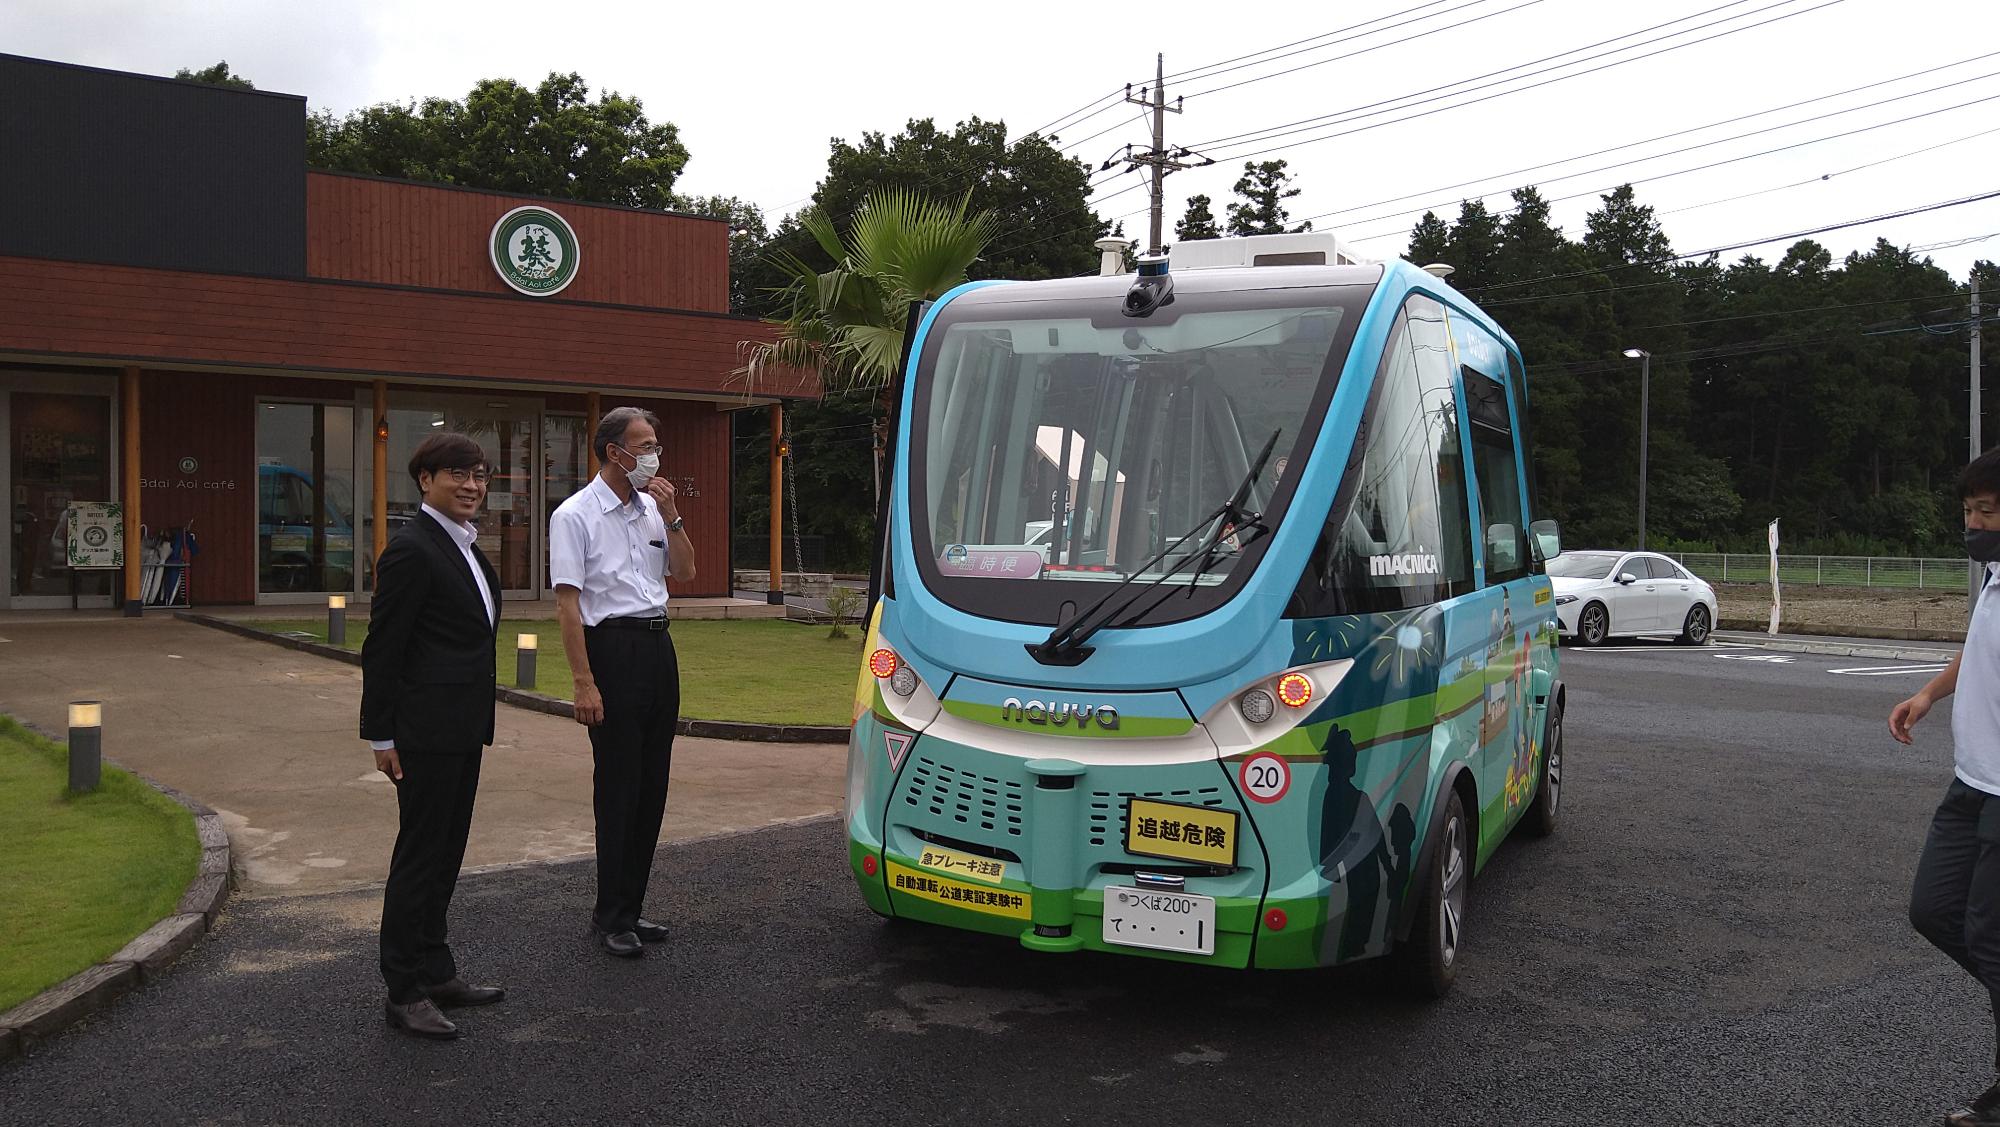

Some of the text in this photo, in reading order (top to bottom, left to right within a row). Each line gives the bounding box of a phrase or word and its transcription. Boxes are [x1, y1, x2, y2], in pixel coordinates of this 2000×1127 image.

[176, 479, 198, 489] Aoi
[1251, 766, 1280, 788] 20
[1137, 816, 1227, 850] 追越危険
[921, 852, 1002, 877] 急ブレーキ注意
